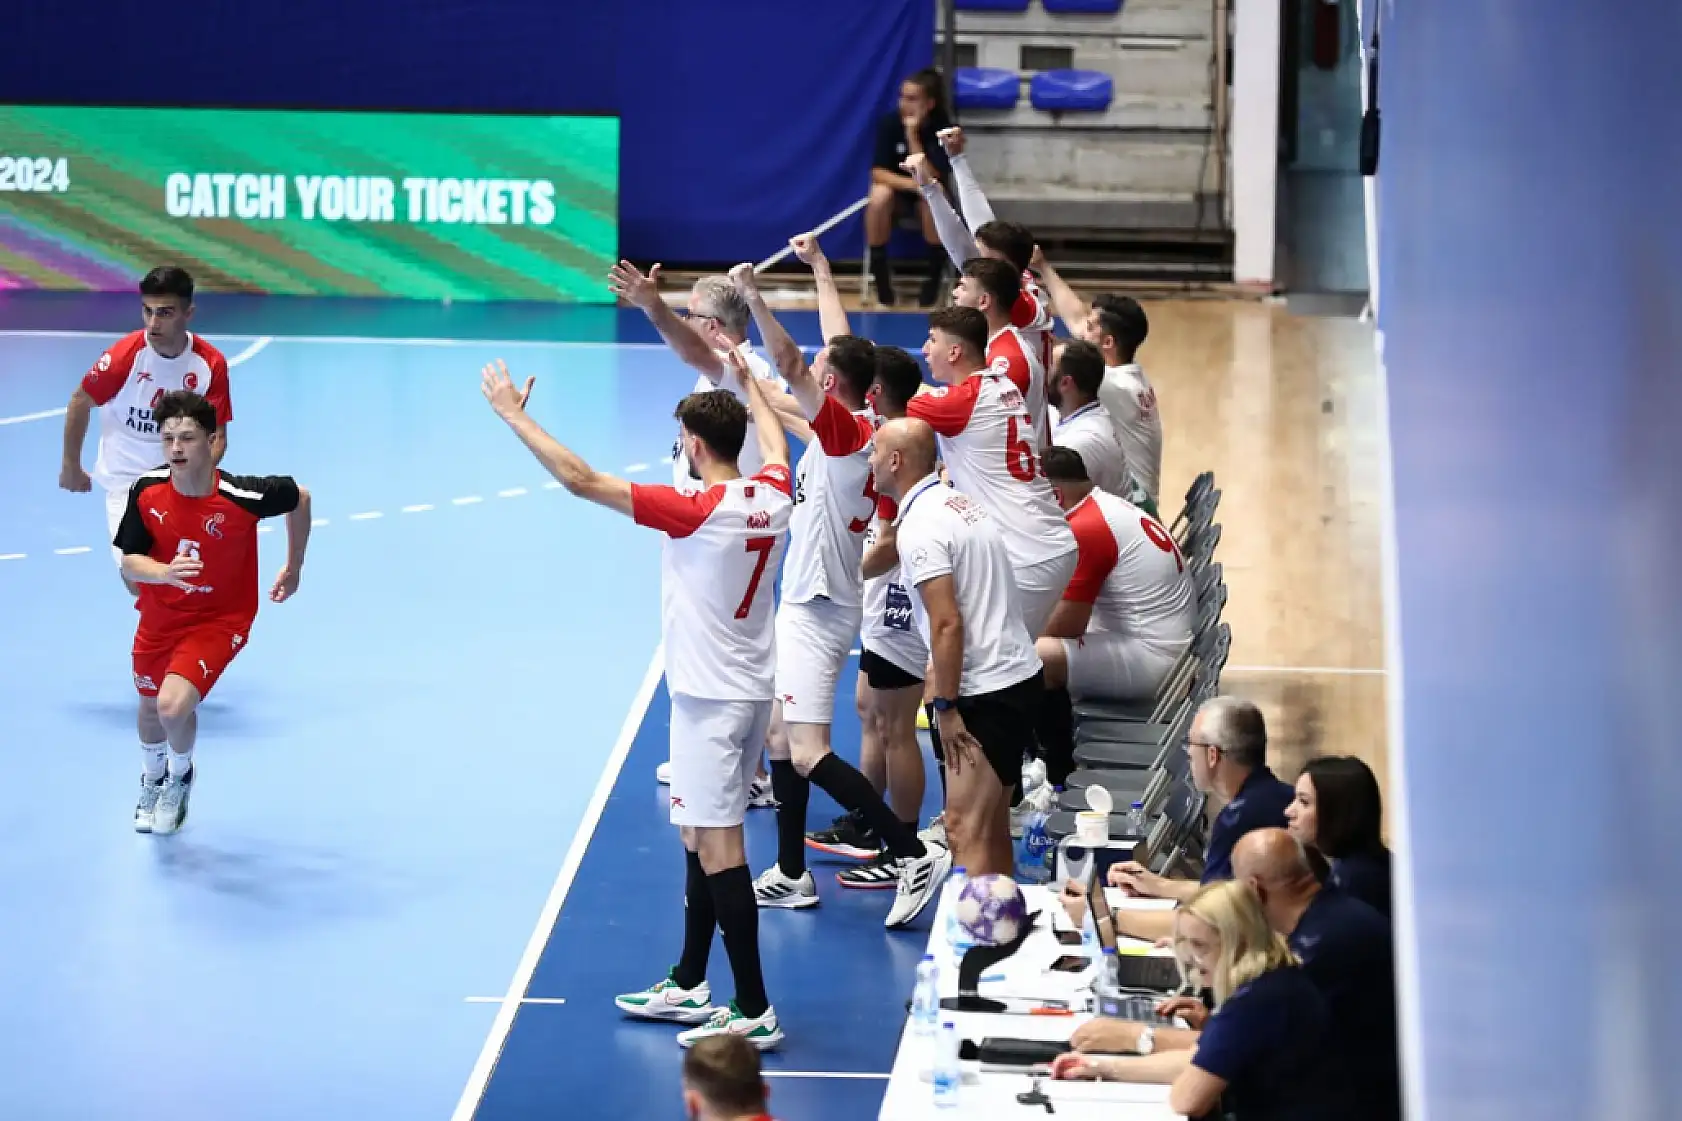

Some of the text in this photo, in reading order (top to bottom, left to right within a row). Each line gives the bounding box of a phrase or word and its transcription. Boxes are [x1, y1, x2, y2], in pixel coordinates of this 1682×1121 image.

[0, 156, 70, 192] 2024
[165, 172, 556, 224] CATCH YOUR TICKETS
[1006, 415, 1035, 482] 6
[1139, 517, 1184, 573] 9
[734, 535, 776, 620] 7
